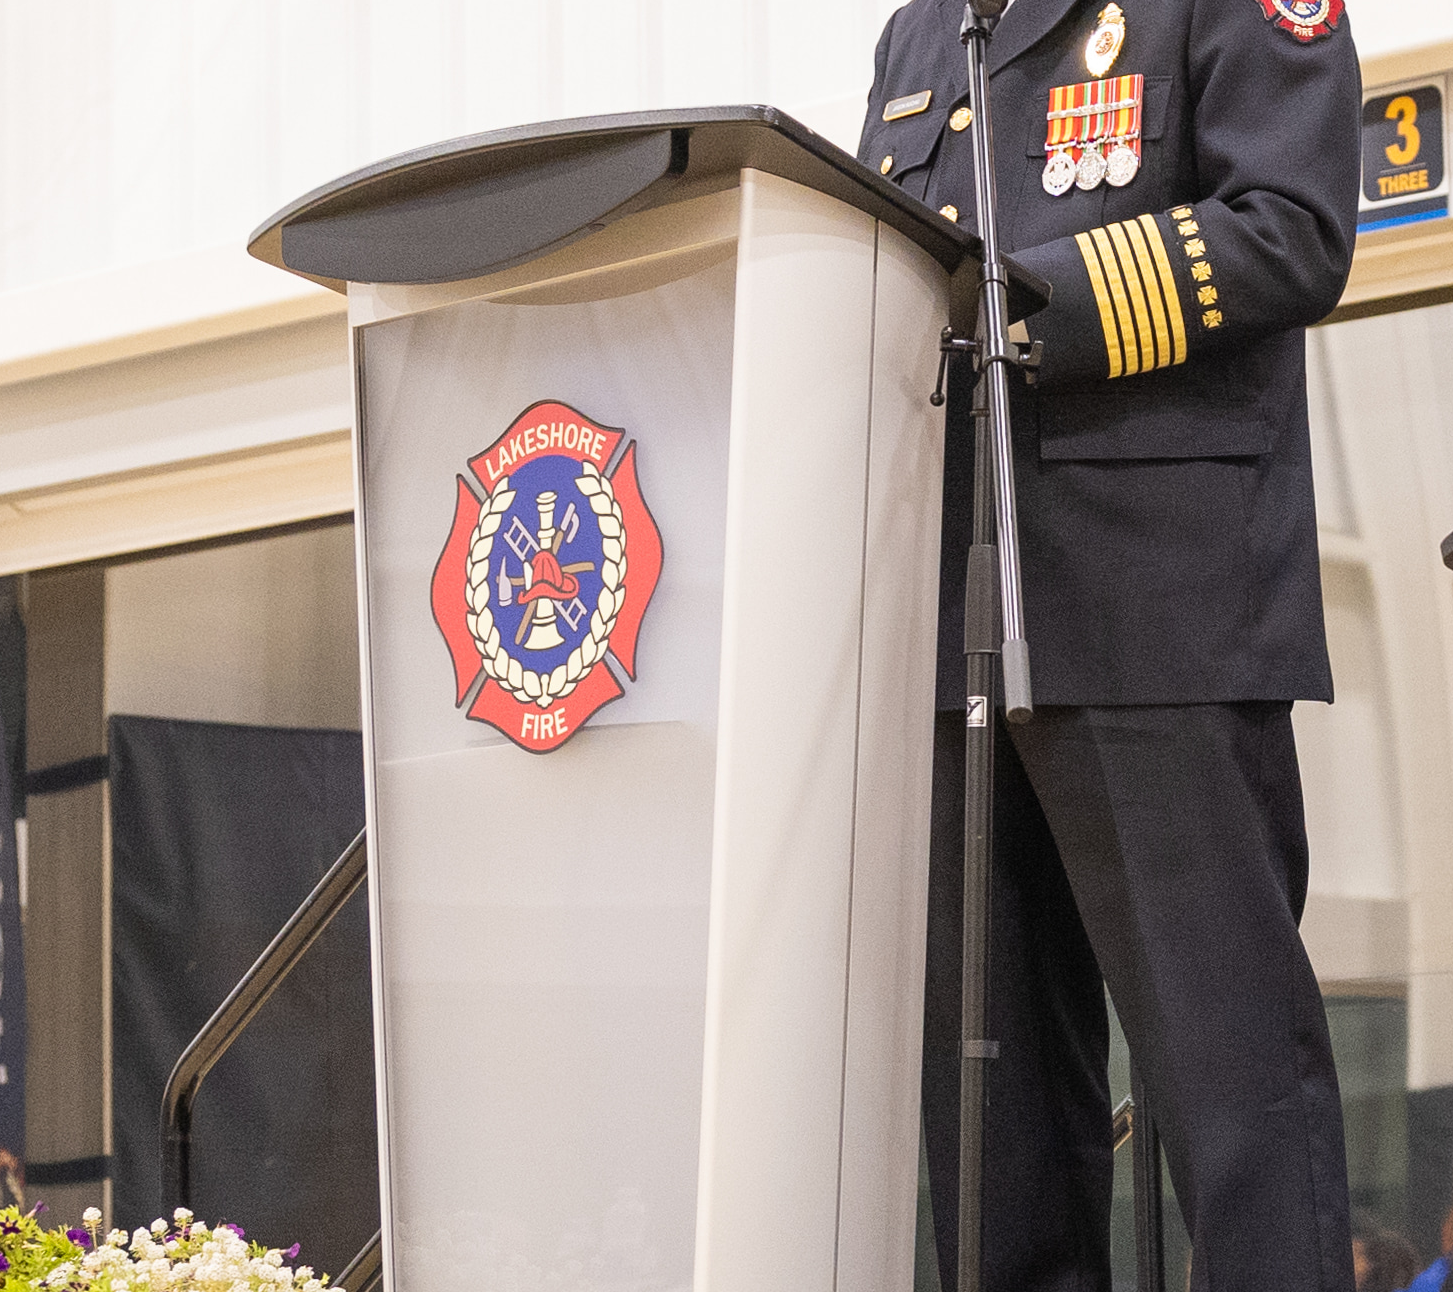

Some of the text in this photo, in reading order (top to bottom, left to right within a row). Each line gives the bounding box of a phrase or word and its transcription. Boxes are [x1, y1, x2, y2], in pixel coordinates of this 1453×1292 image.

[1293, 25, 1314, 37] FIRE
[1385, 96, 1421, 166] 3
[1377, 169, 1429, 197] THREE
[485, 422, 607, 481] LAKESHORE
[520, 707, 568, 739] FIRE
